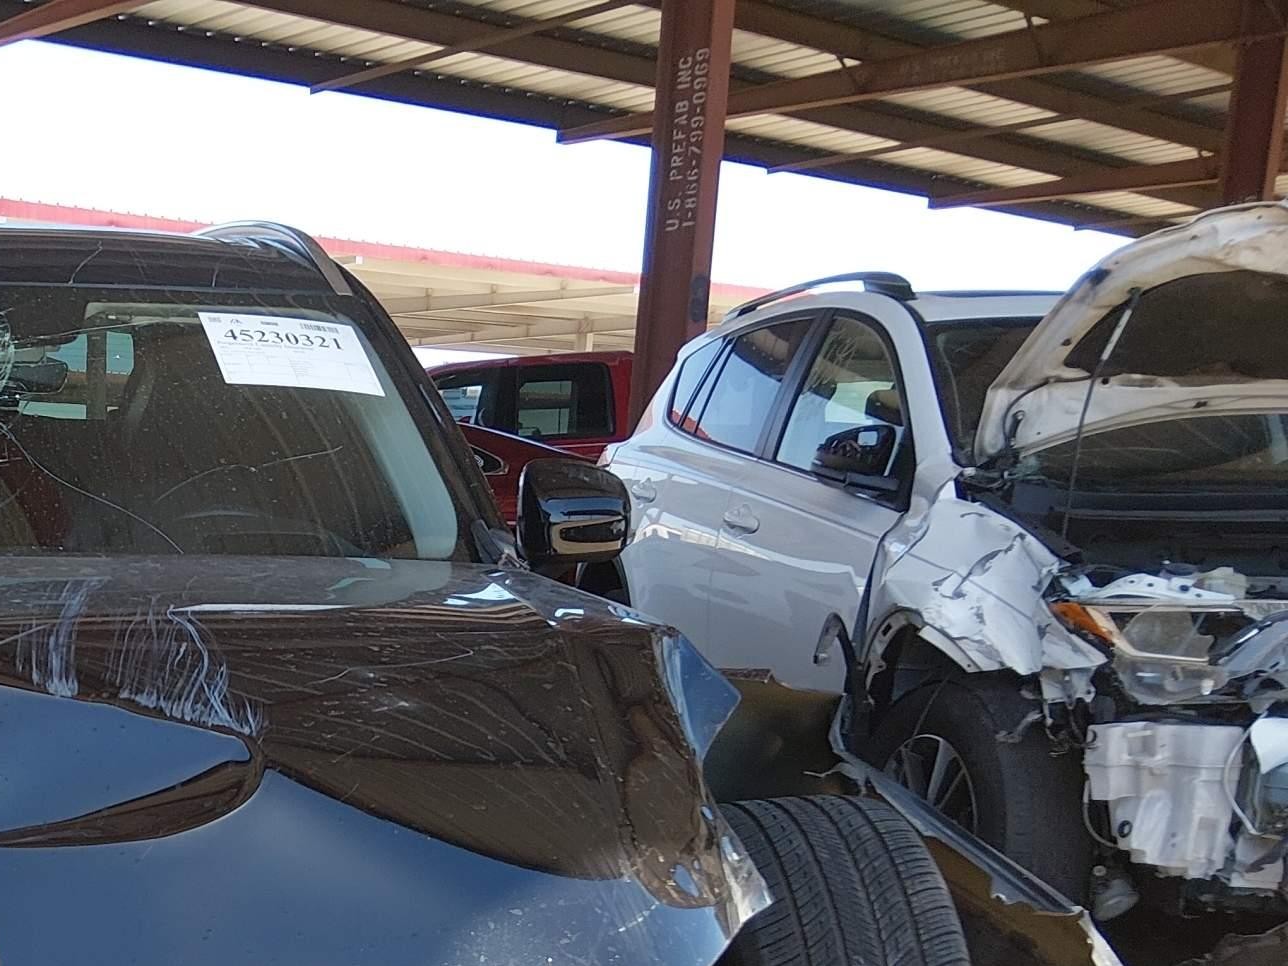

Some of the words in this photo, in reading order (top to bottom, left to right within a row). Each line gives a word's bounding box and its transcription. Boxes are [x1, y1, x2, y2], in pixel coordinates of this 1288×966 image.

[676, 56, 693, 90] INC
[670, 100, 688, 180] PREFAB
[682, 47, 710, 227] 1-866-799-0969
[665, 191, 682, 231] U.S.
[224, 328, 344, 351] 45230321
